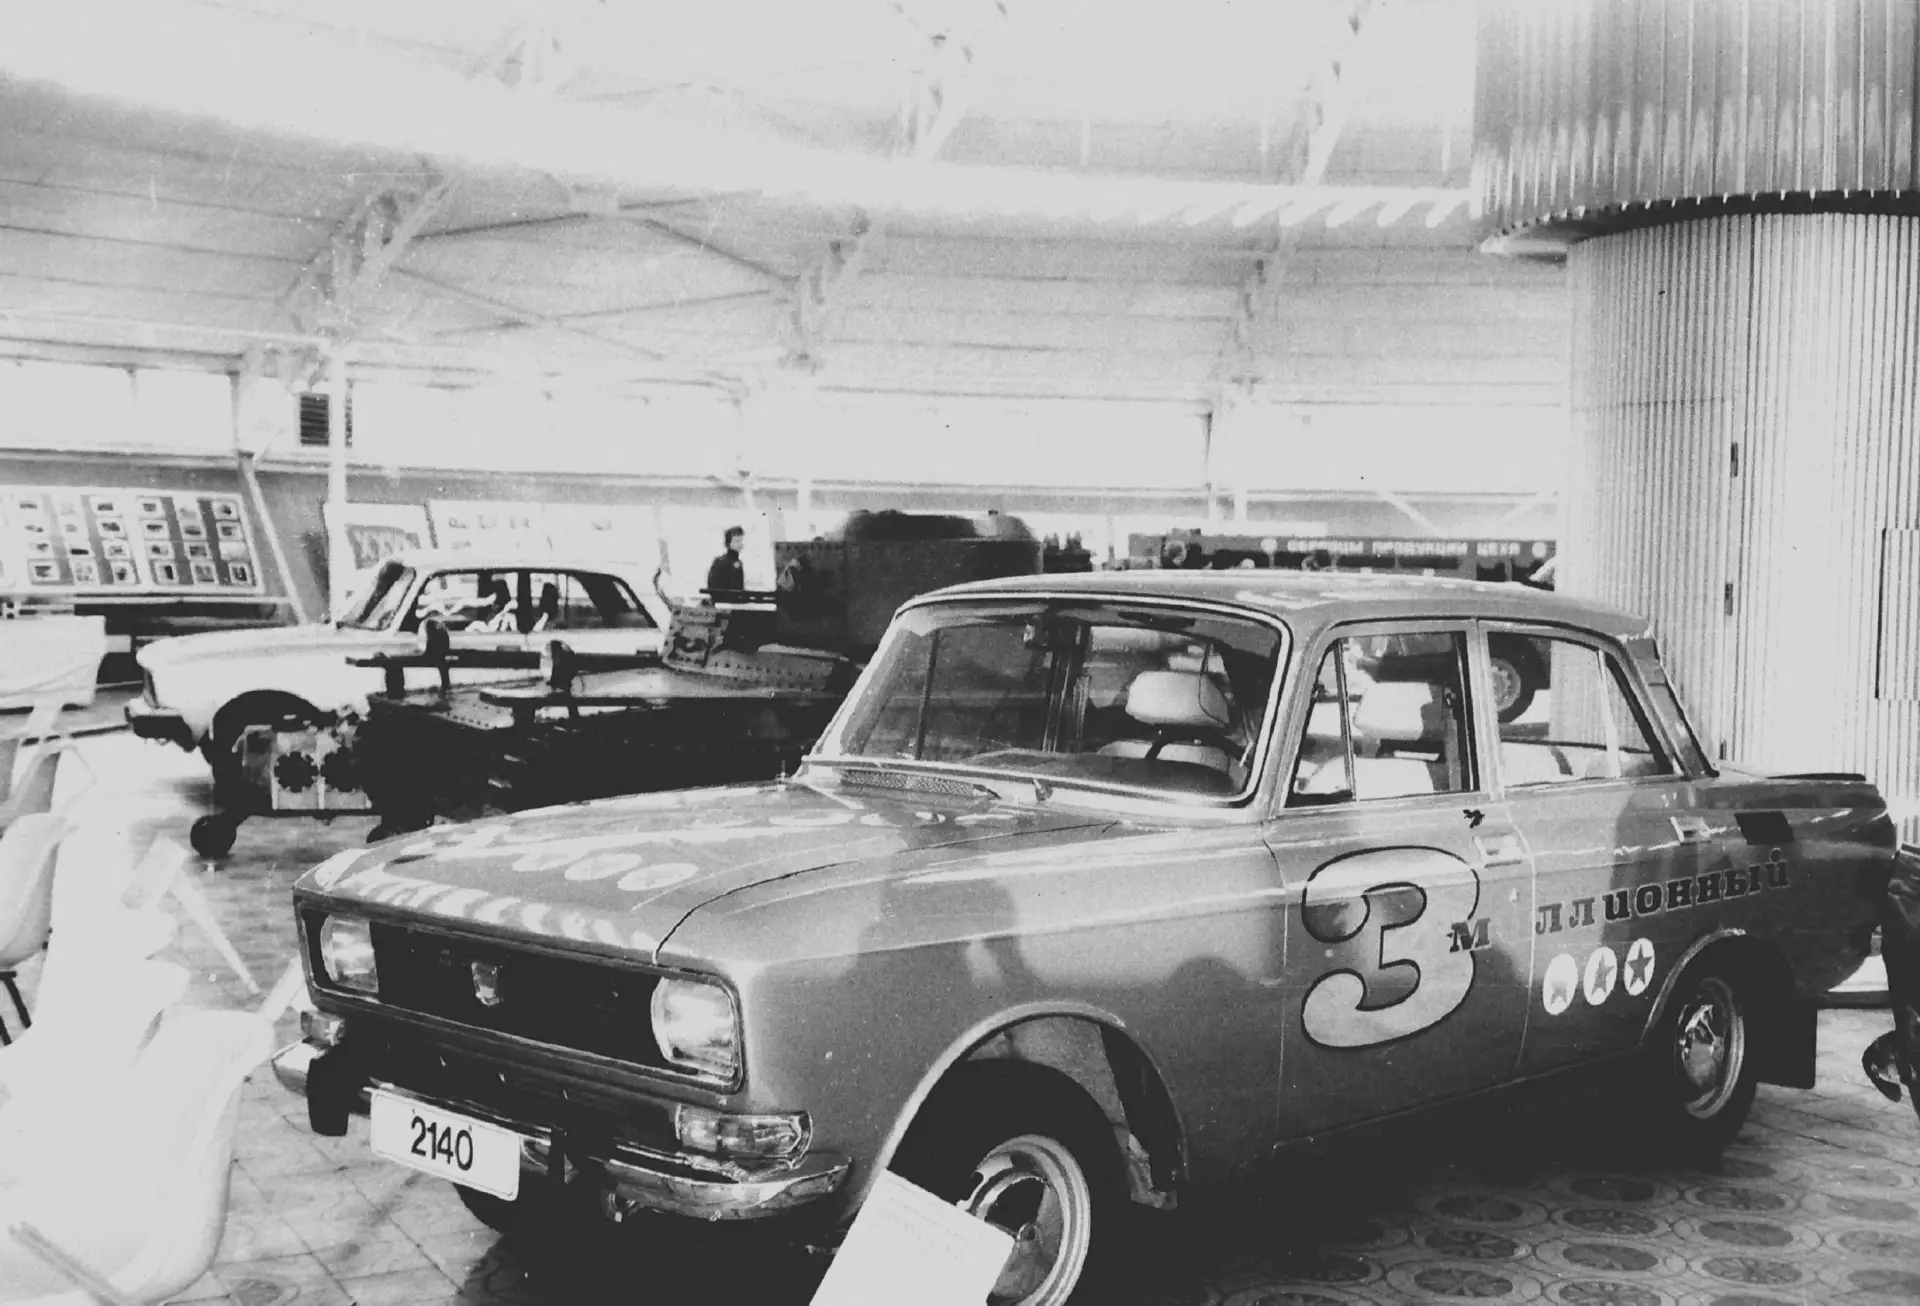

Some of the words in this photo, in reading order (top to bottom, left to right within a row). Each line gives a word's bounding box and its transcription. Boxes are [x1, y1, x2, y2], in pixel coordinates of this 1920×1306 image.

[1476, 540, 1520, 557] ЦЕХА
[1301, 845, 1480, 1049] 3
[411, 1115, 473, 1171] 2140
